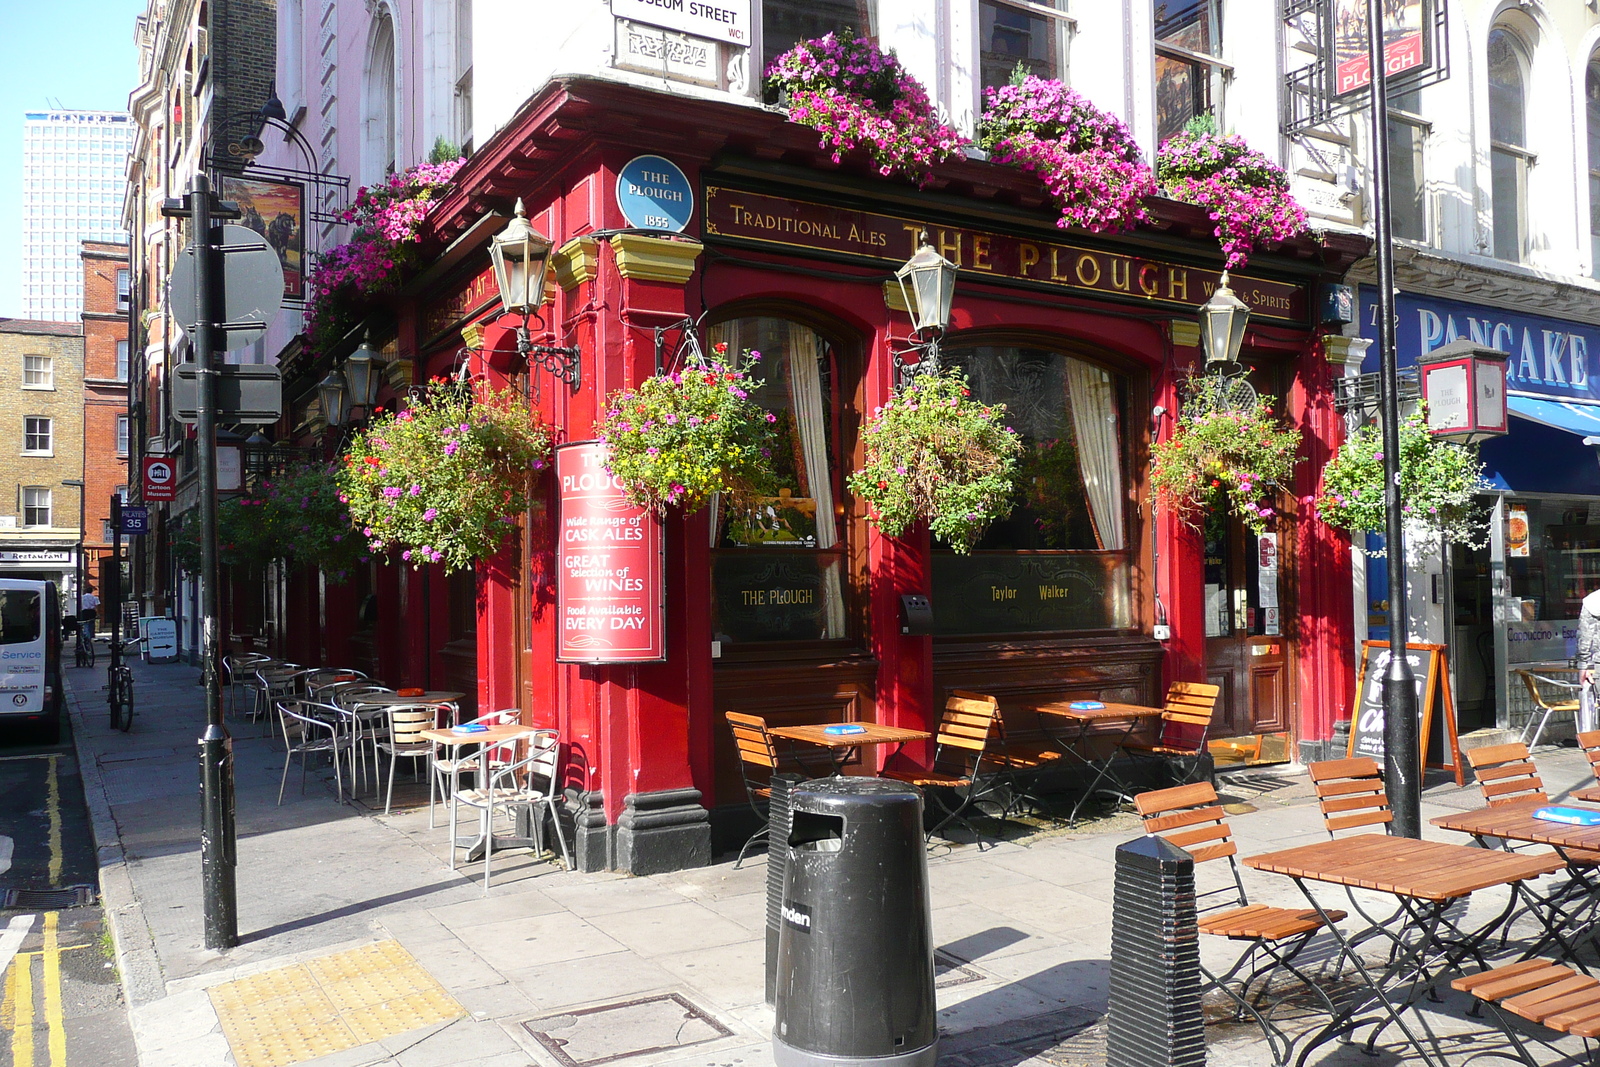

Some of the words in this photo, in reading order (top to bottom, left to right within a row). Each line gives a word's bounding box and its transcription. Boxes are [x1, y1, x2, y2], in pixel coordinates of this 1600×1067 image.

[690, 2, 737, 25] STREET
[728, 27, 744, 40] WC1
[641, 170, 670, 185] THE
[628, 184, 683, 202] PLOUGH
[645, 214, 670, 228] 1855
[903, 223, 992, 270] THE
[1019, 243, 1188, 300] PLOUGH
[1242, 291, 1250, 303] &
[1370, 303, 1399, 329] Te
[1440, 389, 1454, 397] THE
[1433, 397, 1461, 407] PLOUGH
[563, 473, 644, 493] PLOUG
[121, 510, 147, 518] PILATES
[566, 516, 588, 527] Wide
[589, 516, 627, 528] Range
[628, 515, 642, 527] of
[126, 519, 142, 528] 35
[565, 528, 599, 542] CASK
[602, 527, 643, 541] ALES
[565, 554, 611, 569] GREAT
[571, 567, 614, 578] Selection
[615, 566, 630, 579] of
[585, 578, 643, 592] WINES
[741, 590, 766, 606] THE
[769, 588, 813, 605] PLOUGH
[991, 585, 1018, 602] Taylor
[1039, 585, 1069, 600] Walker
[567, 606, 587, 616] Food
[588, 604, 643, 616] Available
[565, 617, 606, 631] EVERY
[610, 616, 646, 630] DAY
[1507, 626, 1553, 643] Cappuccino
[2, 651, 42, 659] Service
[781, 904, 811, 927] mden
